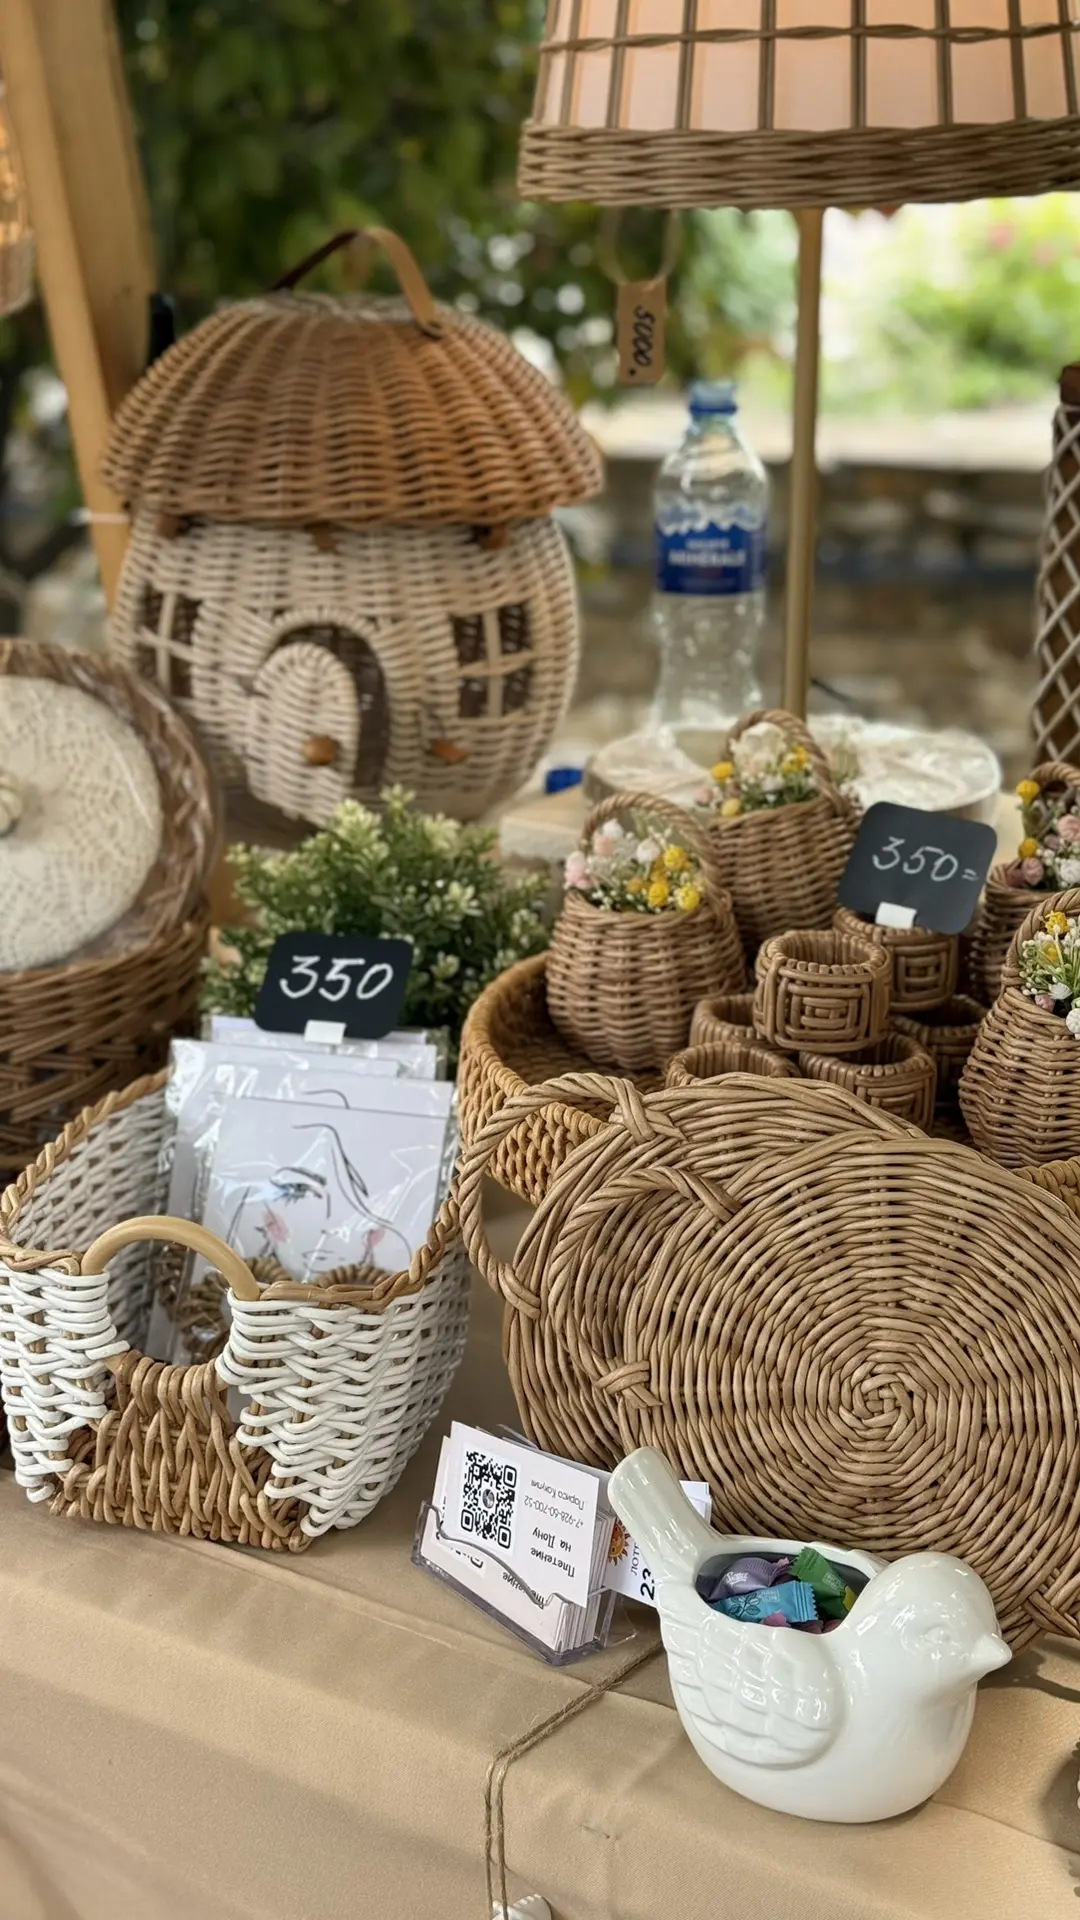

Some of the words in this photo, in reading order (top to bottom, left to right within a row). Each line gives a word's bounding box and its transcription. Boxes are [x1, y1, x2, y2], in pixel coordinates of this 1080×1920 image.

[279, 954, 394, 1002] 350
[531, 1526, 556, 1549] Дону
[559, 1540, 572, 1553] на
[530, 1546, 576, 1578] Плетение
